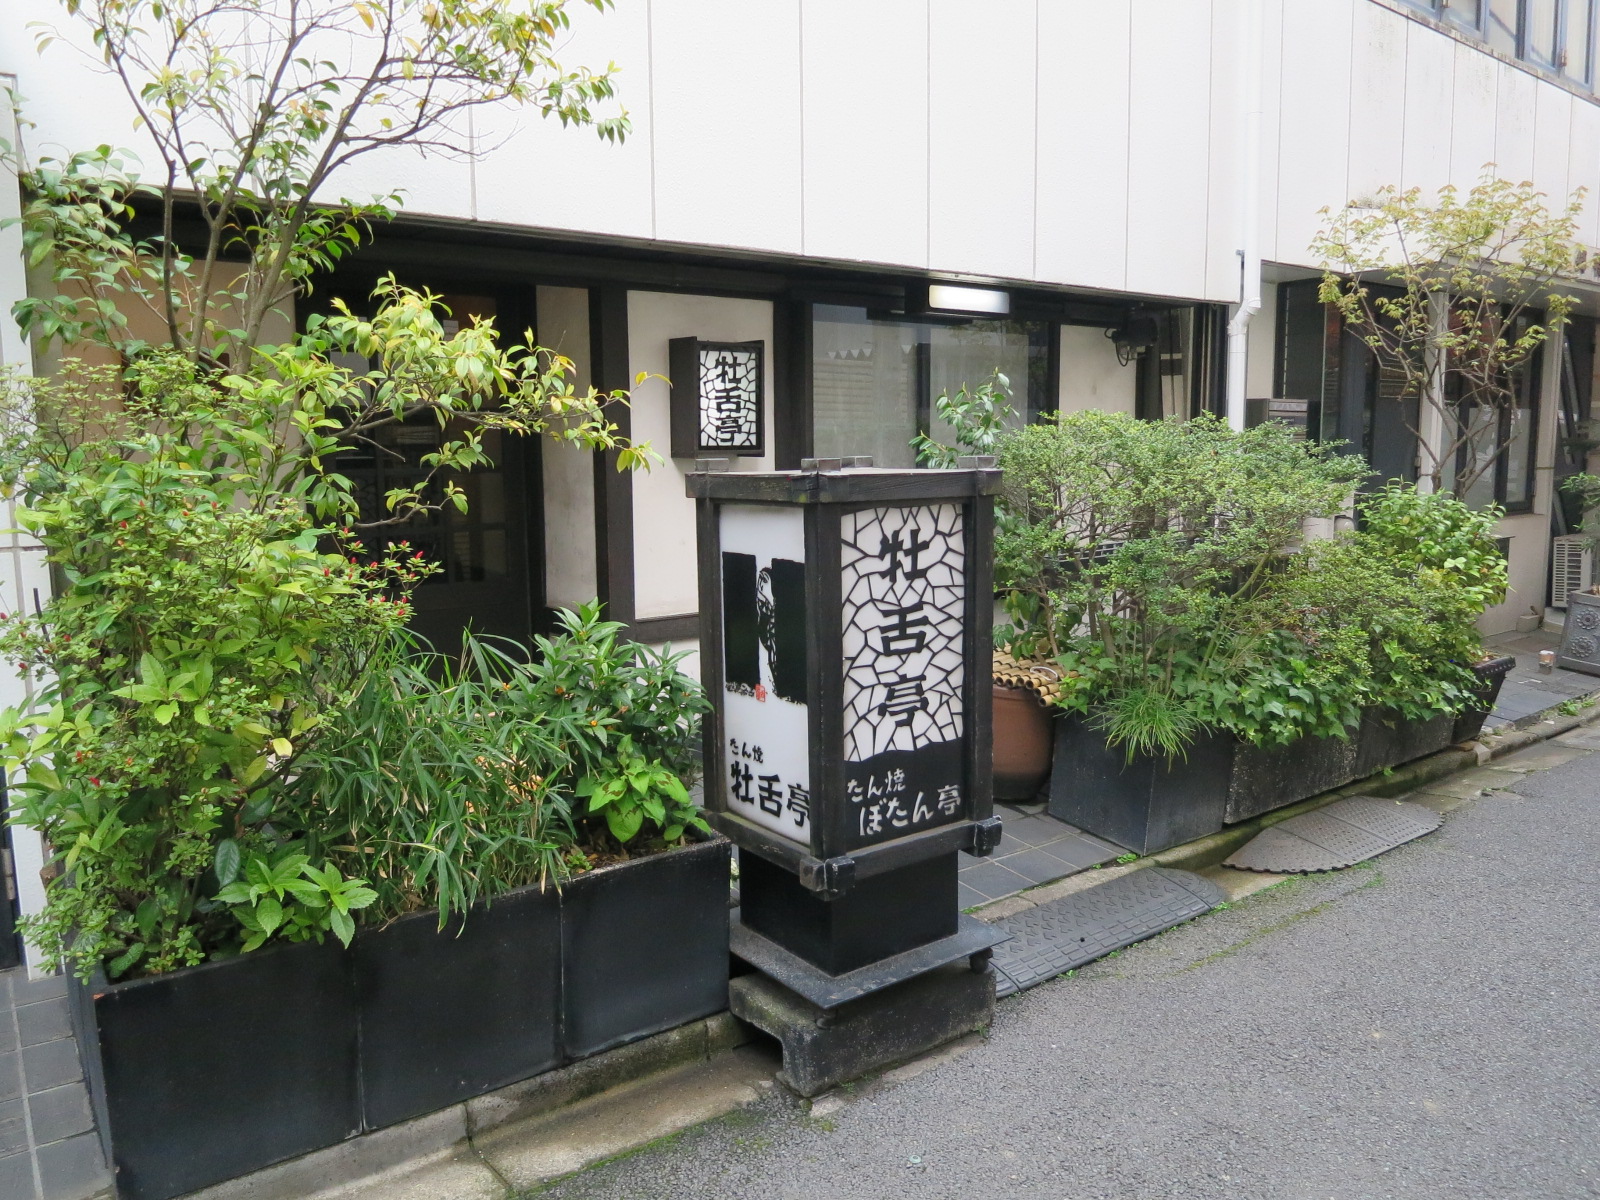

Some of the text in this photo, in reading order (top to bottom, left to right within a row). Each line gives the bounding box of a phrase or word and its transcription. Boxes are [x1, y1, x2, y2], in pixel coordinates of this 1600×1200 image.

[715, 355, 742, 442] 牡舌亭
[880, 529, 930, 727] 牡舌亭
[729, 738, 763, 763] たん焼
[730, 760, 810, 827] 牡舌亭
[847, 768, 906, 803] たん焼
[859, 785, 961, 836] ぼたん亭
